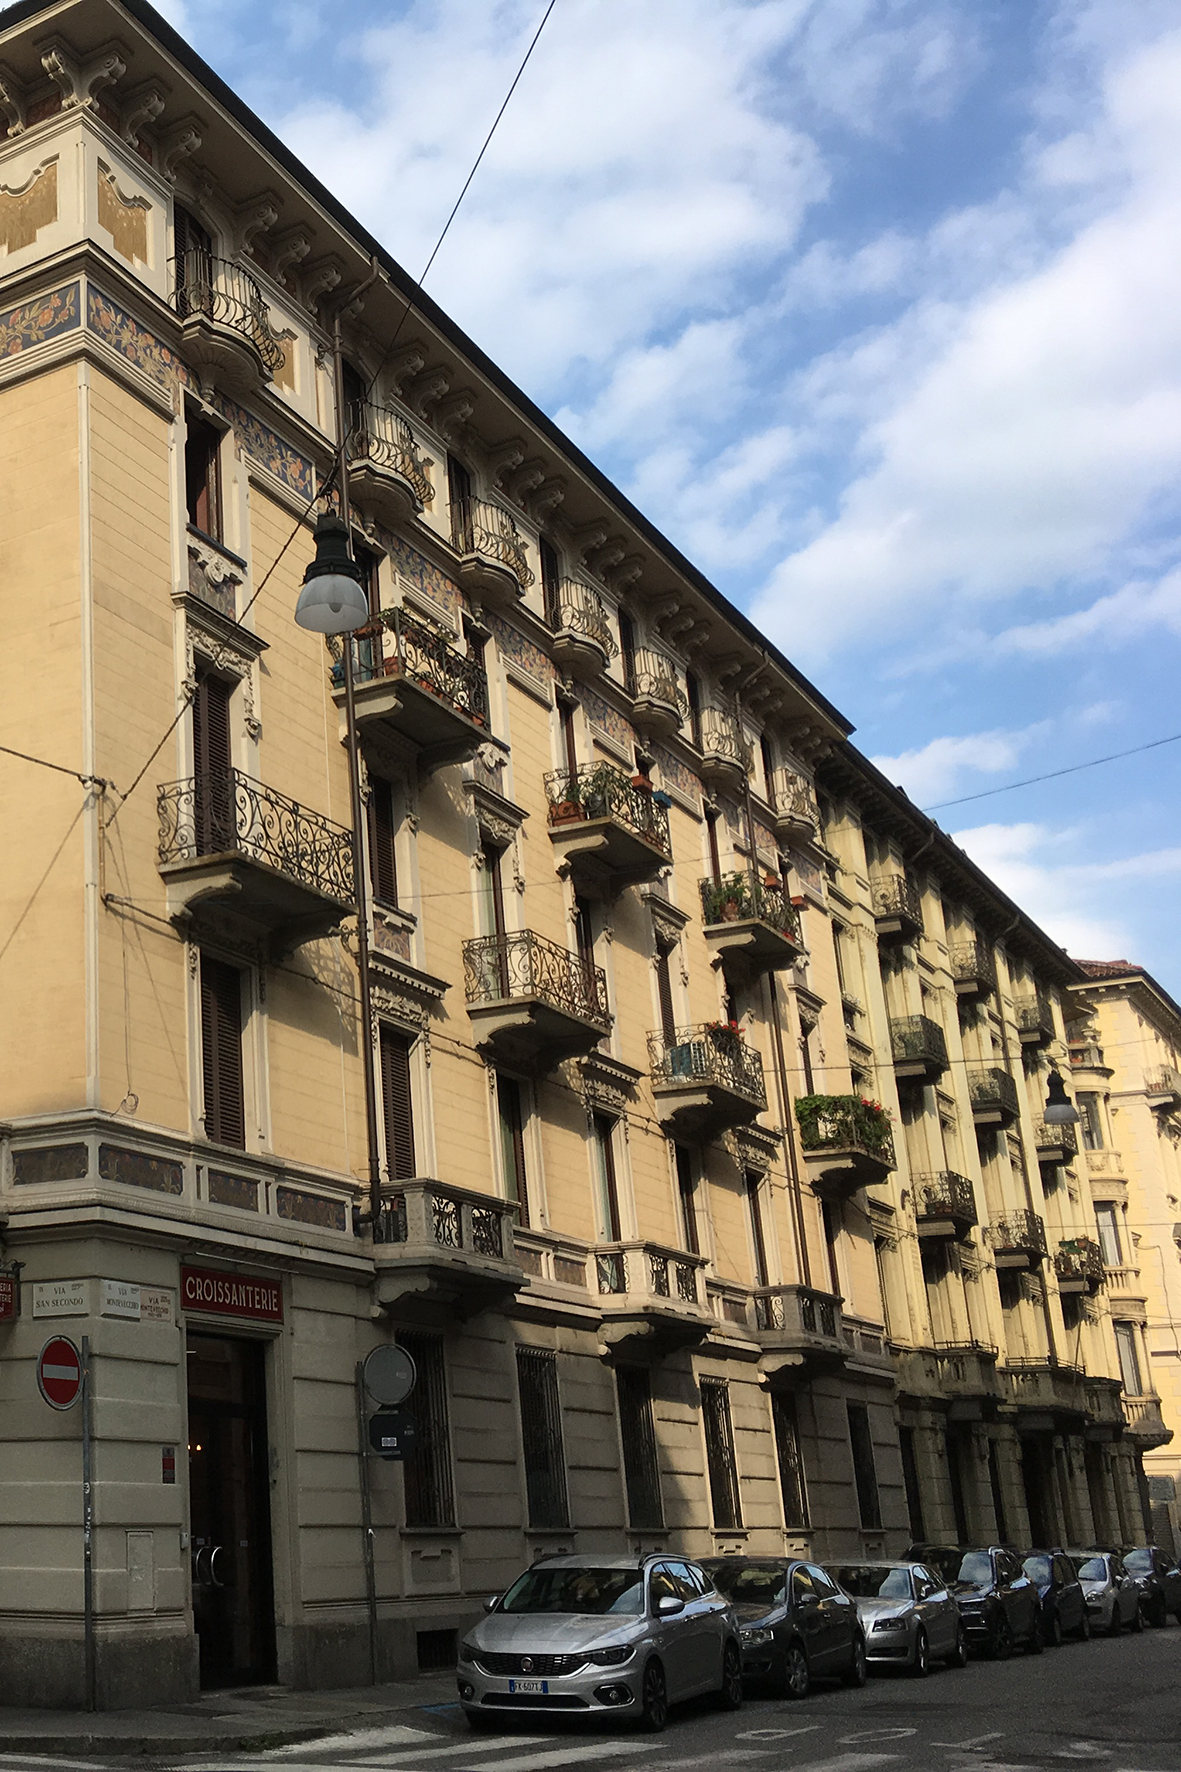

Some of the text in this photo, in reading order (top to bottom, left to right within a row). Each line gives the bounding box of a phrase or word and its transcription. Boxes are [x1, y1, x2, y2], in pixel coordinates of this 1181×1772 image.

[53, 1287, 66, 1295] VIA
[186, 1276, 279, 1312] CROISSANTERIE
[35, 1297, 84, 1308] SAN SECONDO
[148, 1296, 160, 1305] VIA
